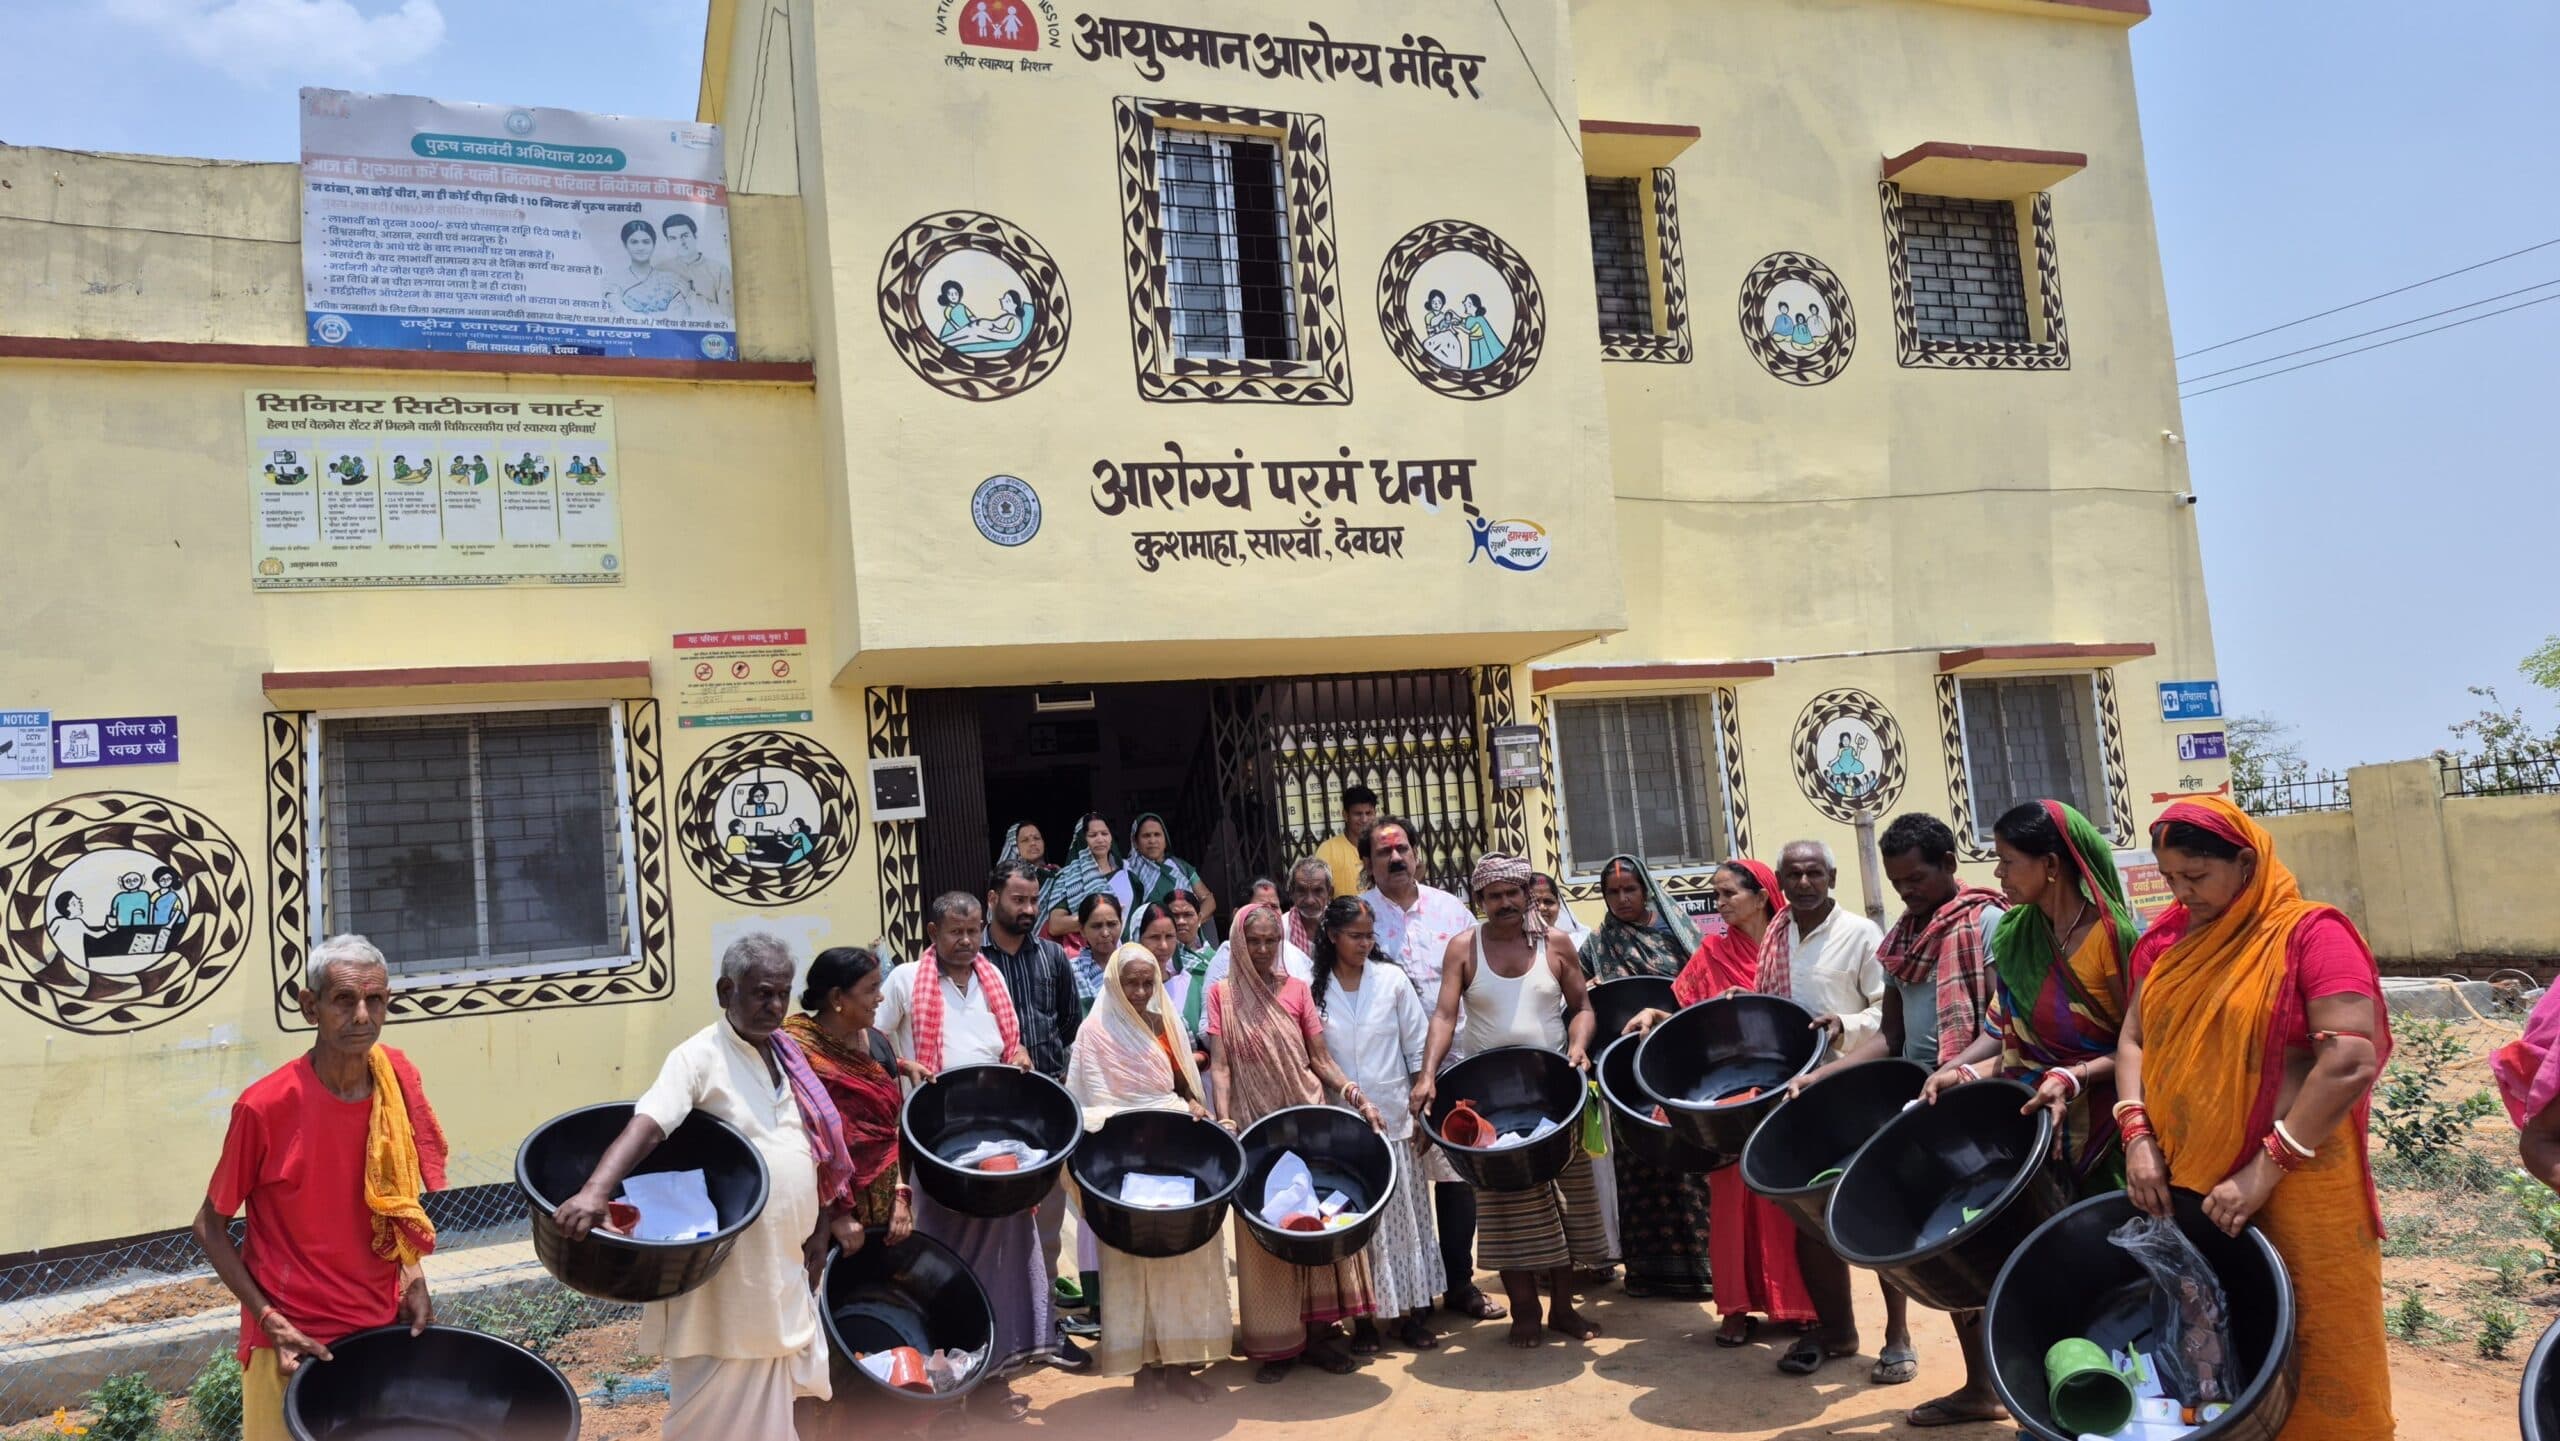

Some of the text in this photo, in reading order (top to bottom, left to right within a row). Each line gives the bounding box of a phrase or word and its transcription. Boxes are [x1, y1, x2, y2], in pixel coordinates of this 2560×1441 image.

[936, 0, 955, 35] NATI
[945, 52, 976, 68] राष्ट्रीय
[1020, 58, 1053, 72] मिशन
[1072, 13, 1487, 100] आयुष्मान आरोग्य मंदिर
[463, 137, 512, 158] नसबंदी
[516, 143, 574, 164] अभियान
[577, 153, 614, 165] 2024
[311, 157, 716, 201] आज ही करें पति-पत्नी मिलकर परिवार नियोजन की बात करें
[312, 183, 323, 192] न
[356, 187, 368, 195] ना
[372, 185, 393, 198] कोई
[395, 187, 419, 200] चीरा,
[422, 191, 434, 200] ना
[436, 189, 447, 201] ही
[449, 189, 469, 202] कोई
[527, 197, 538, 206] 10
[540, 196, 569, 210] मिनट
[571, 197, 582, 211] में
[608, 201, 642, 214] नसबंदी
[328, 214, 366, 226] लाभार्थी
[367, 216, 380, 226] को
[410, 220, 443, 229] 3000/-
[552, 228, 570, 239] जाते
[445, 230, 458, 241] एवं
[330, 238, 370, 249] ऑपरेशन
[373, 239, 383, 250] के
[423, 241, 433, 252] के
[435, 243, 451, 253] बाद
[453, 243, 488, 255] लाभार्थी
[505, 248, 516, 257] जा
[519, 248, 543, 259] सकते
[330, 250, 591, 274] नसबंदी के बाद लाभार्थी सामान्य से दैनिक कार्य कर सकते
[371, 262, 388, 273] और
[413, 265, 434, 276] पहले
[460, 267, 468, 278] ही
[491, 269, 511, 280] रहता
[330, 273, 499, 291] इस विधि में चीरा लगाया जाता है ही
[340, 302, 377, 313] जानकारी
[379, 287, 420, 299] ऑपरेशन
[422, 289, 432, 299] के
[434, 291, 453, 300] साथ
[480, 292, 512, 303] नसबंदी
[515, 293, 526, 304] भी
[528, 296, 557, 305] कराया
[559, 298, 570, 306] जा
[572, 298, 600, 309] सकता
[400, 318, 652, 340] राष्ट्रीय स्वास्थ्य झारखण्ड
[466, 340, 488, 352] जिला
[490, 343, 520, 353] स्वास्थ्य
[554, 345, 578, 355] देवघर
[256, 393, 604, 417] सिनियर सिटीजन चार्टर
[267, 417, 597, 436] हेल्थ एवं वेलनेस सेंटर में मिलने वाली चिकित्सकीय एवं स्वास्थ्य सुविधाएं
[1090, 441, 1480, 517] आरोग्यं परमं धनम्
[1132, 530, 1247, 573] कुशमाहा,
[1334, 517, 1405, 560] देवघर
[3, 714, 40, 725] NOTICE
[106, 719, 166, 737] परिसर को
[107, 739, 166, 756] स्वच्छ रखें
[2178, 775, 2203, 790] महिला
